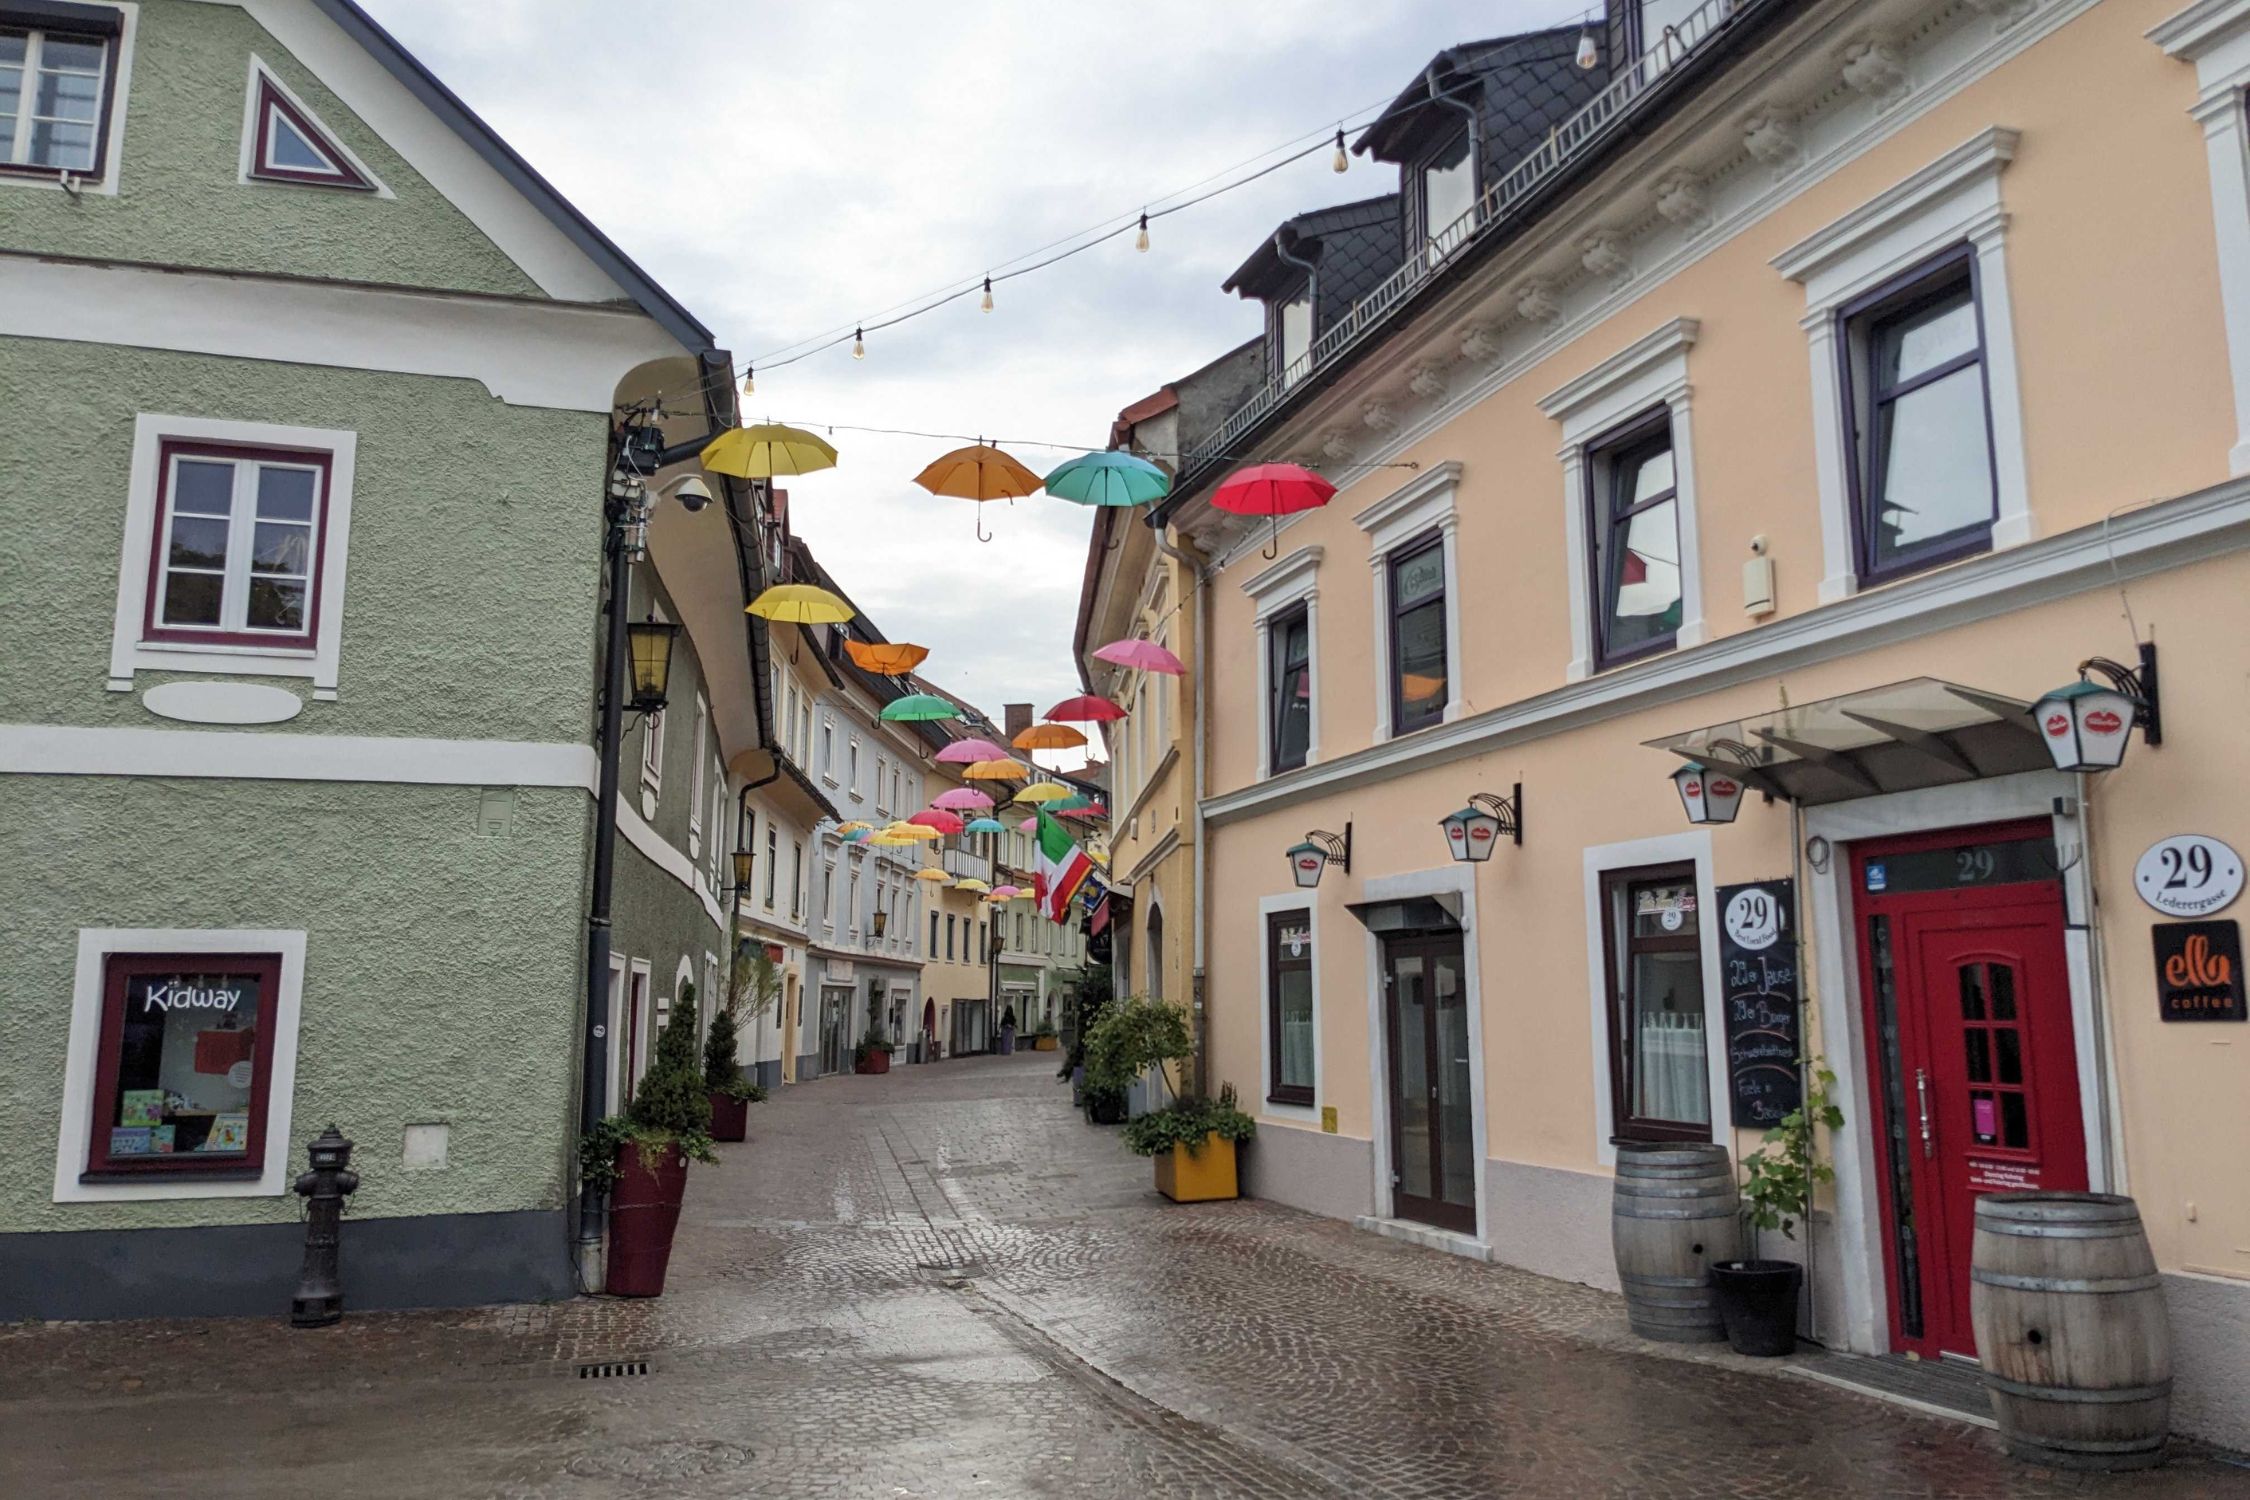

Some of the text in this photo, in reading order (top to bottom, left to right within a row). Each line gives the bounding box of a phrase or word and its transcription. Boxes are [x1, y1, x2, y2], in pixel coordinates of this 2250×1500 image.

[1956, 849, 1995, 882] 29
[2160, 844, 2213, 890] 29
[1740, 896, 1768, 930] 29
[2156, 889, 2227, 912] Lederergasse
[2165, 934, 2232, 987] ella
[2171, 995, 2234, 1009] coffee
